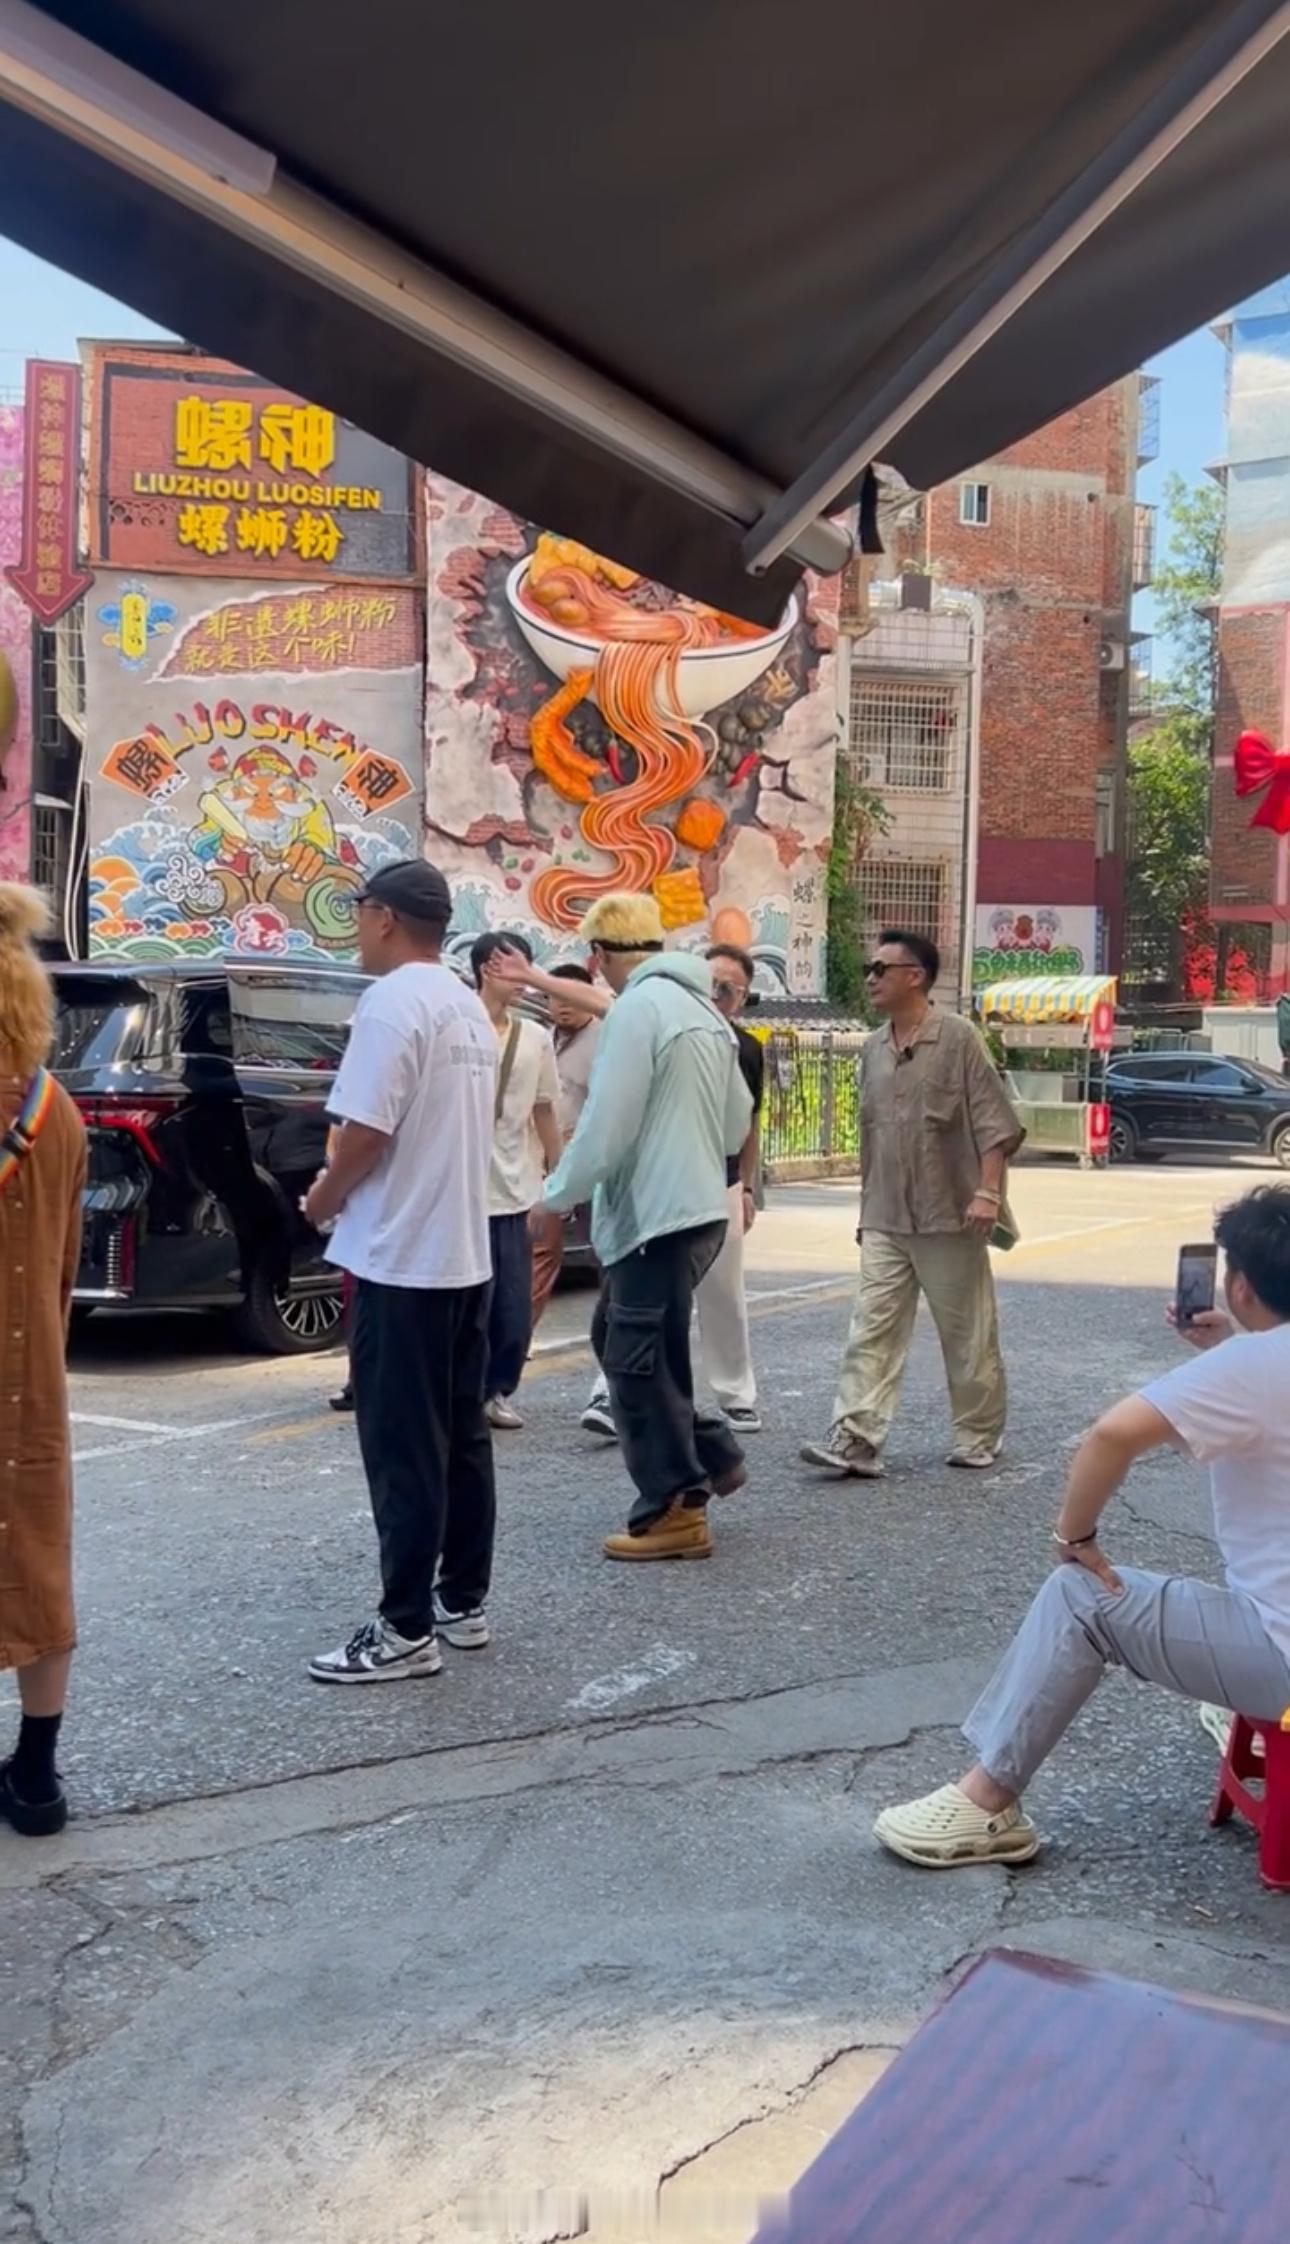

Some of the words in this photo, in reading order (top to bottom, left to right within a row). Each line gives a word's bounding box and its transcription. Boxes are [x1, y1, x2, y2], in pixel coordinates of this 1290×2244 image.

[177, 395, 335, 478] 螺神
[133, 471, 250, 501] LIUZHOU
[257, 482, 381, 510] LUOSIFEN
[178, 503, 345, 562] 螺蛳粉
[357, 759, 400, 799] 神
